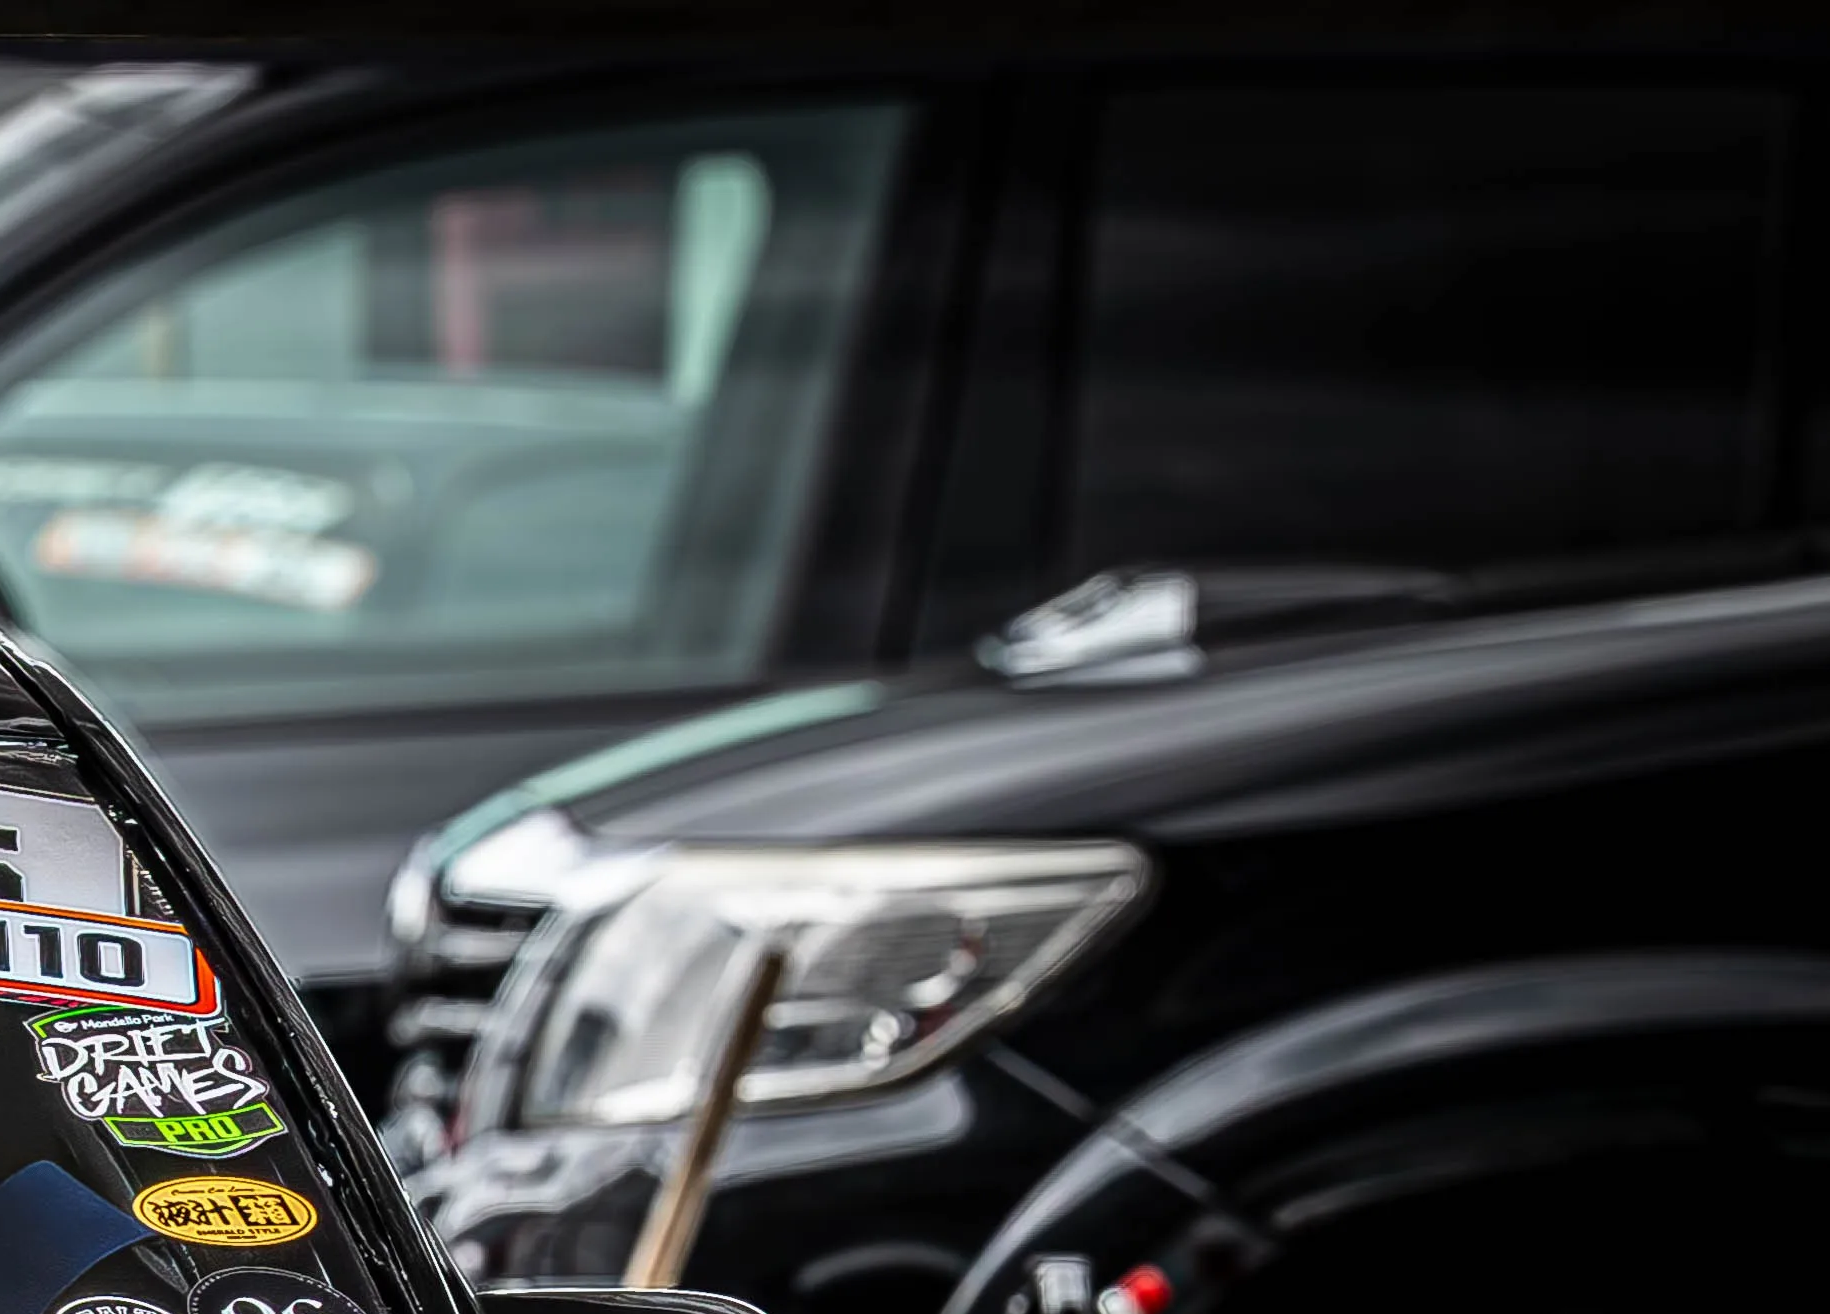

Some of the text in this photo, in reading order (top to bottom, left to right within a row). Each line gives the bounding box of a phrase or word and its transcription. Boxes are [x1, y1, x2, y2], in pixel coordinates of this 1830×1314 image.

[142, 1013, 175, 1026] Park
[39, 1018, 227, 1081] DRIFT
[67, 1049, 267, 1118] GAMES
[154, 1115, 243, 1143] PRO
